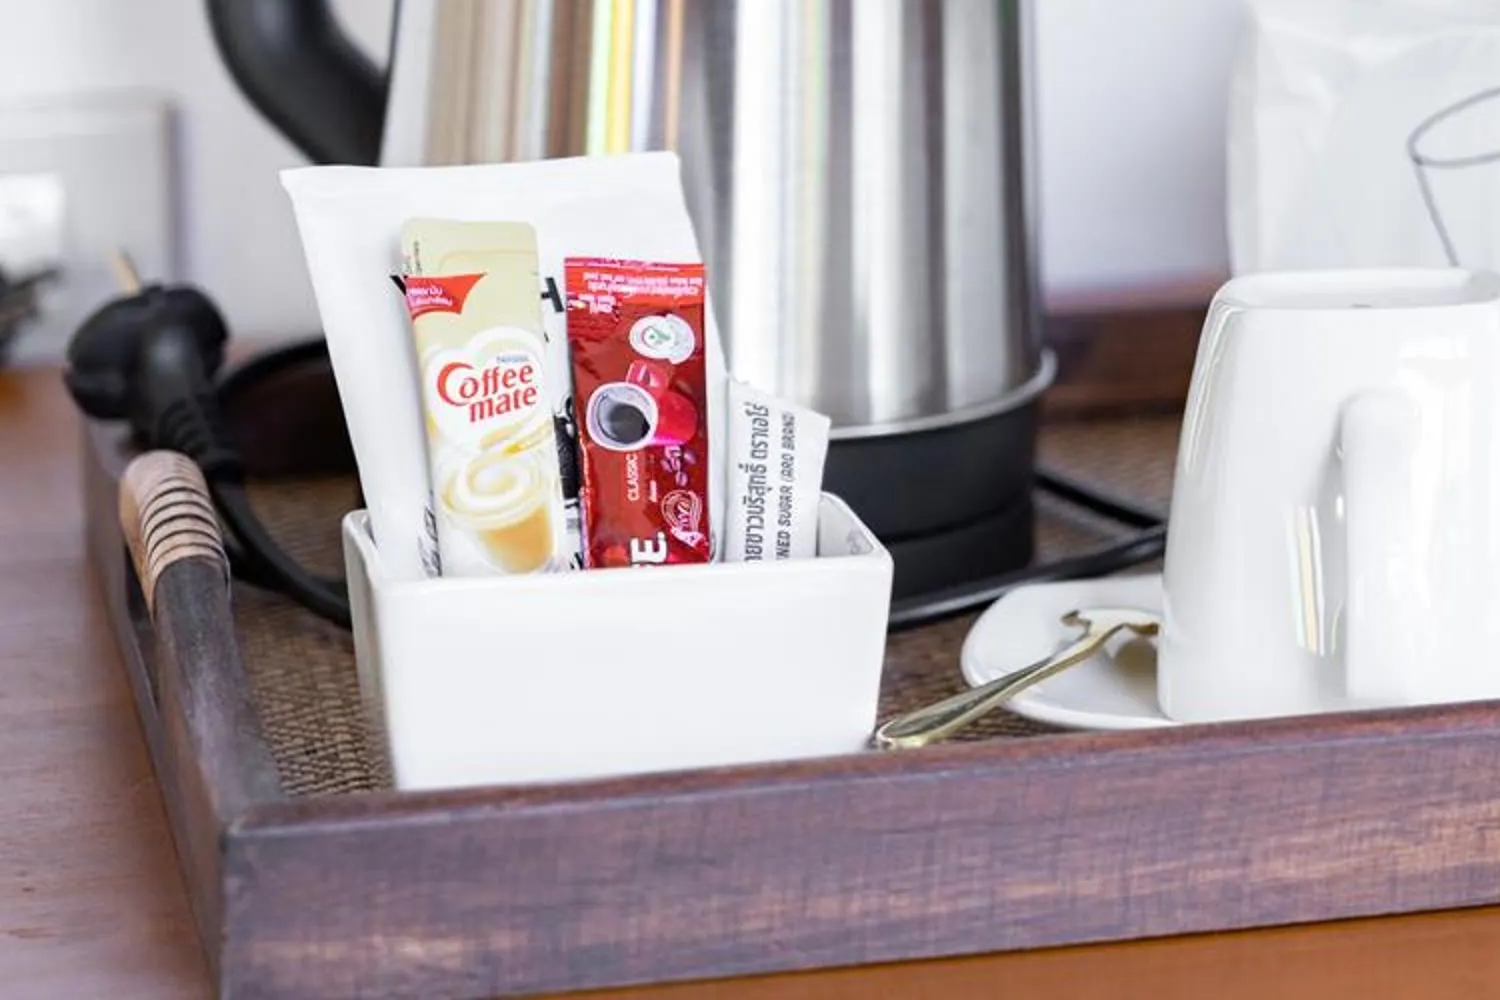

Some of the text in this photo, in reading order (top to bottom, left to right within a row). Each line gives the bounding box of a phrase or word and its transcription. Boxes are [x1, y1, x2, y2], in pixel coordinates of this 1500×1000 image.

[437, 362, 533, 407] Coffee
[469, 386, 537, 422] mate
[625, 453, 640, 501] CLASSIC
[778, 485, 793, 527] SUGAR
[776, 530, 791, 561] NED
